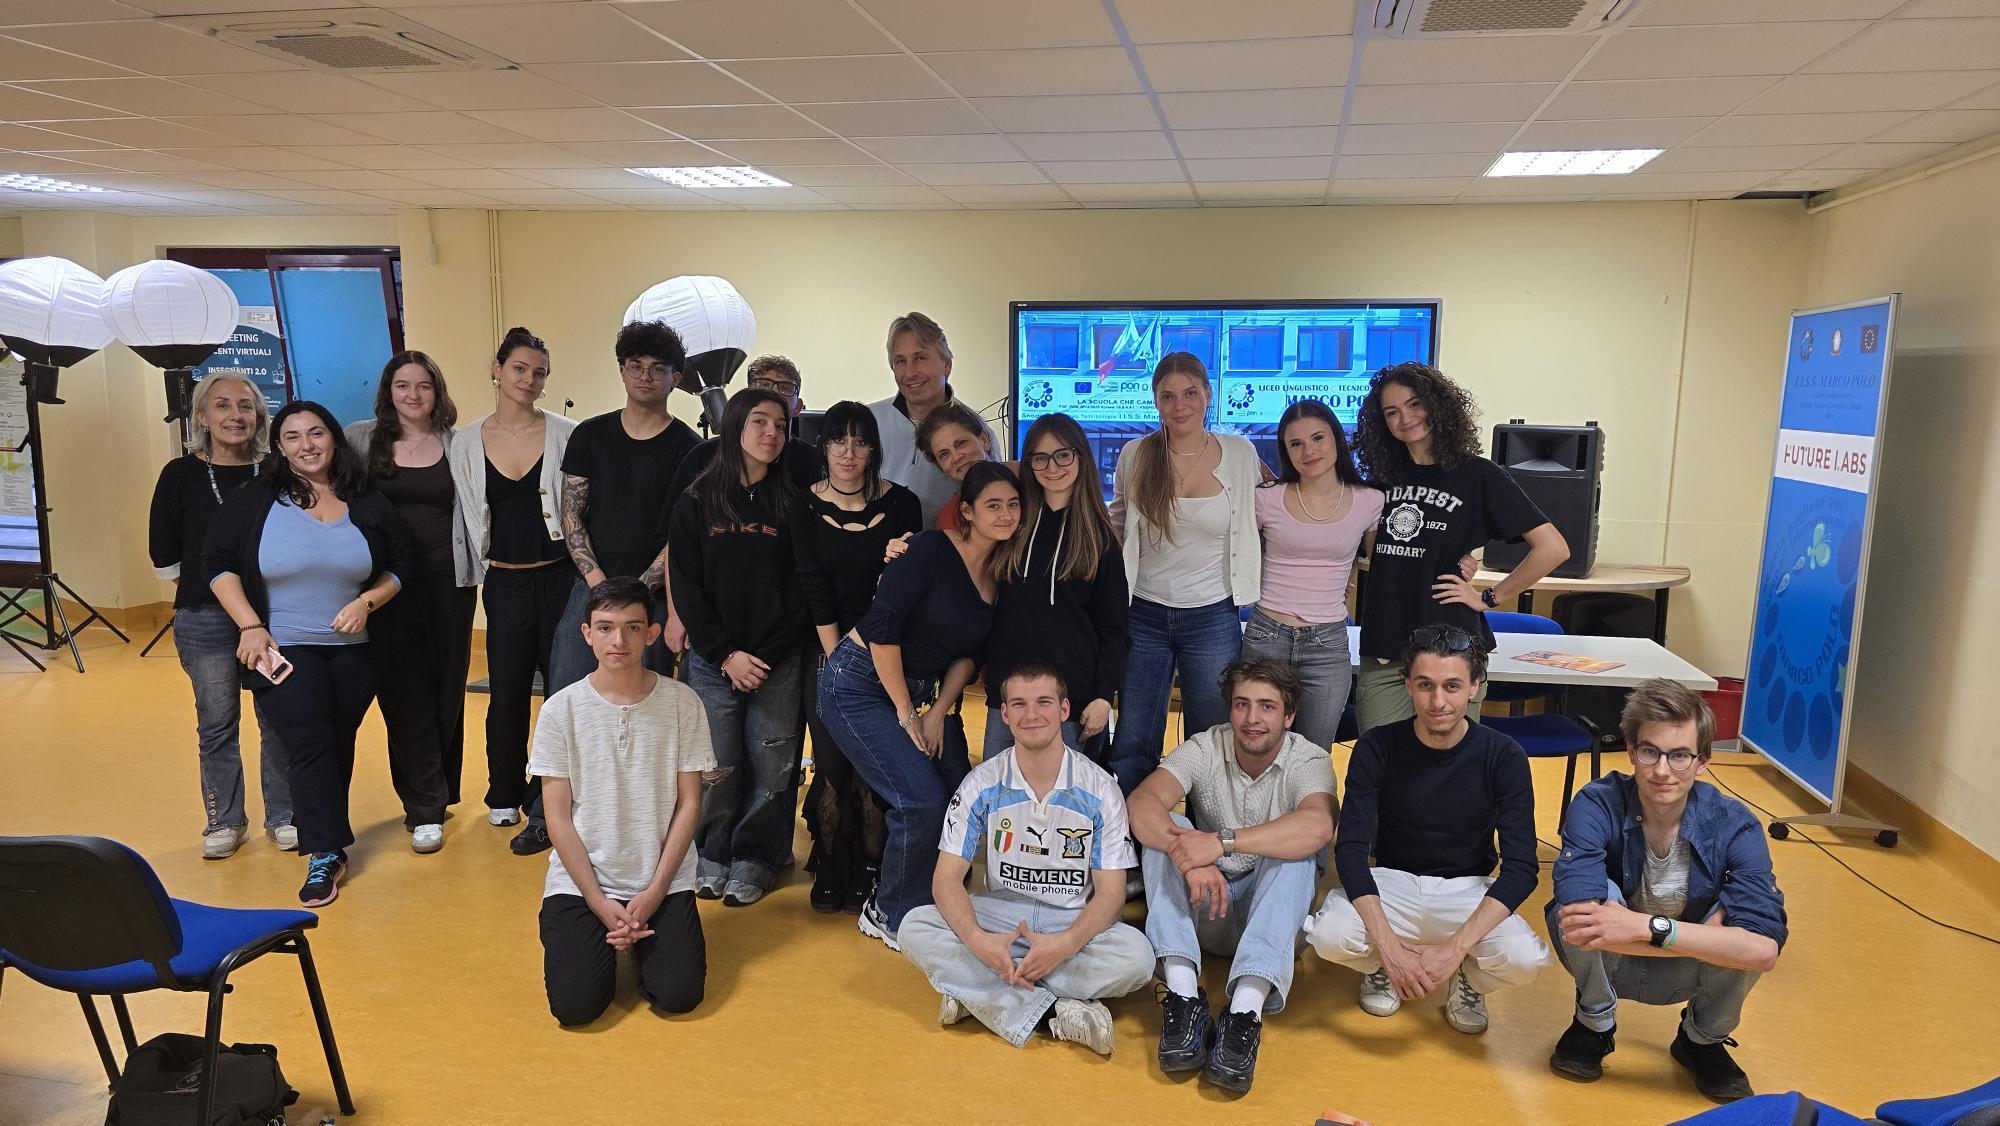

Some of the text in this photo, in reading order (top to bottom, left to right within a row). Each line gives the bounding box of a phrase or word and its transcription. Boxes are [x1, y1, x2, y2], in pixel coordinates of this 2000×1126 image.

[226, 333, 259, 343] EETING
[235, 348, 272, 356] VIRTUALI
[234, 357, 240, 365] &
[254, 368, 267, 376] 2.0
[1820, 375, 1850, 388] MARCO
[1851, 374, 1876, 388] POLO
[1120, 381, 1140, 393] pon
[1258, 384, 1280, 392] LICEO
[1338, 384, 1370, 392] TECNICO
[1784, 444, 1867, 475] FUTURE LABS
[1425, 521, 1448, 531] 1873
[1376, 543, 1426, 558] HUNGARY
[1001, 863, 1084, 885] SIEMENS
[1002, 880, 1080, 896] mobile phones
